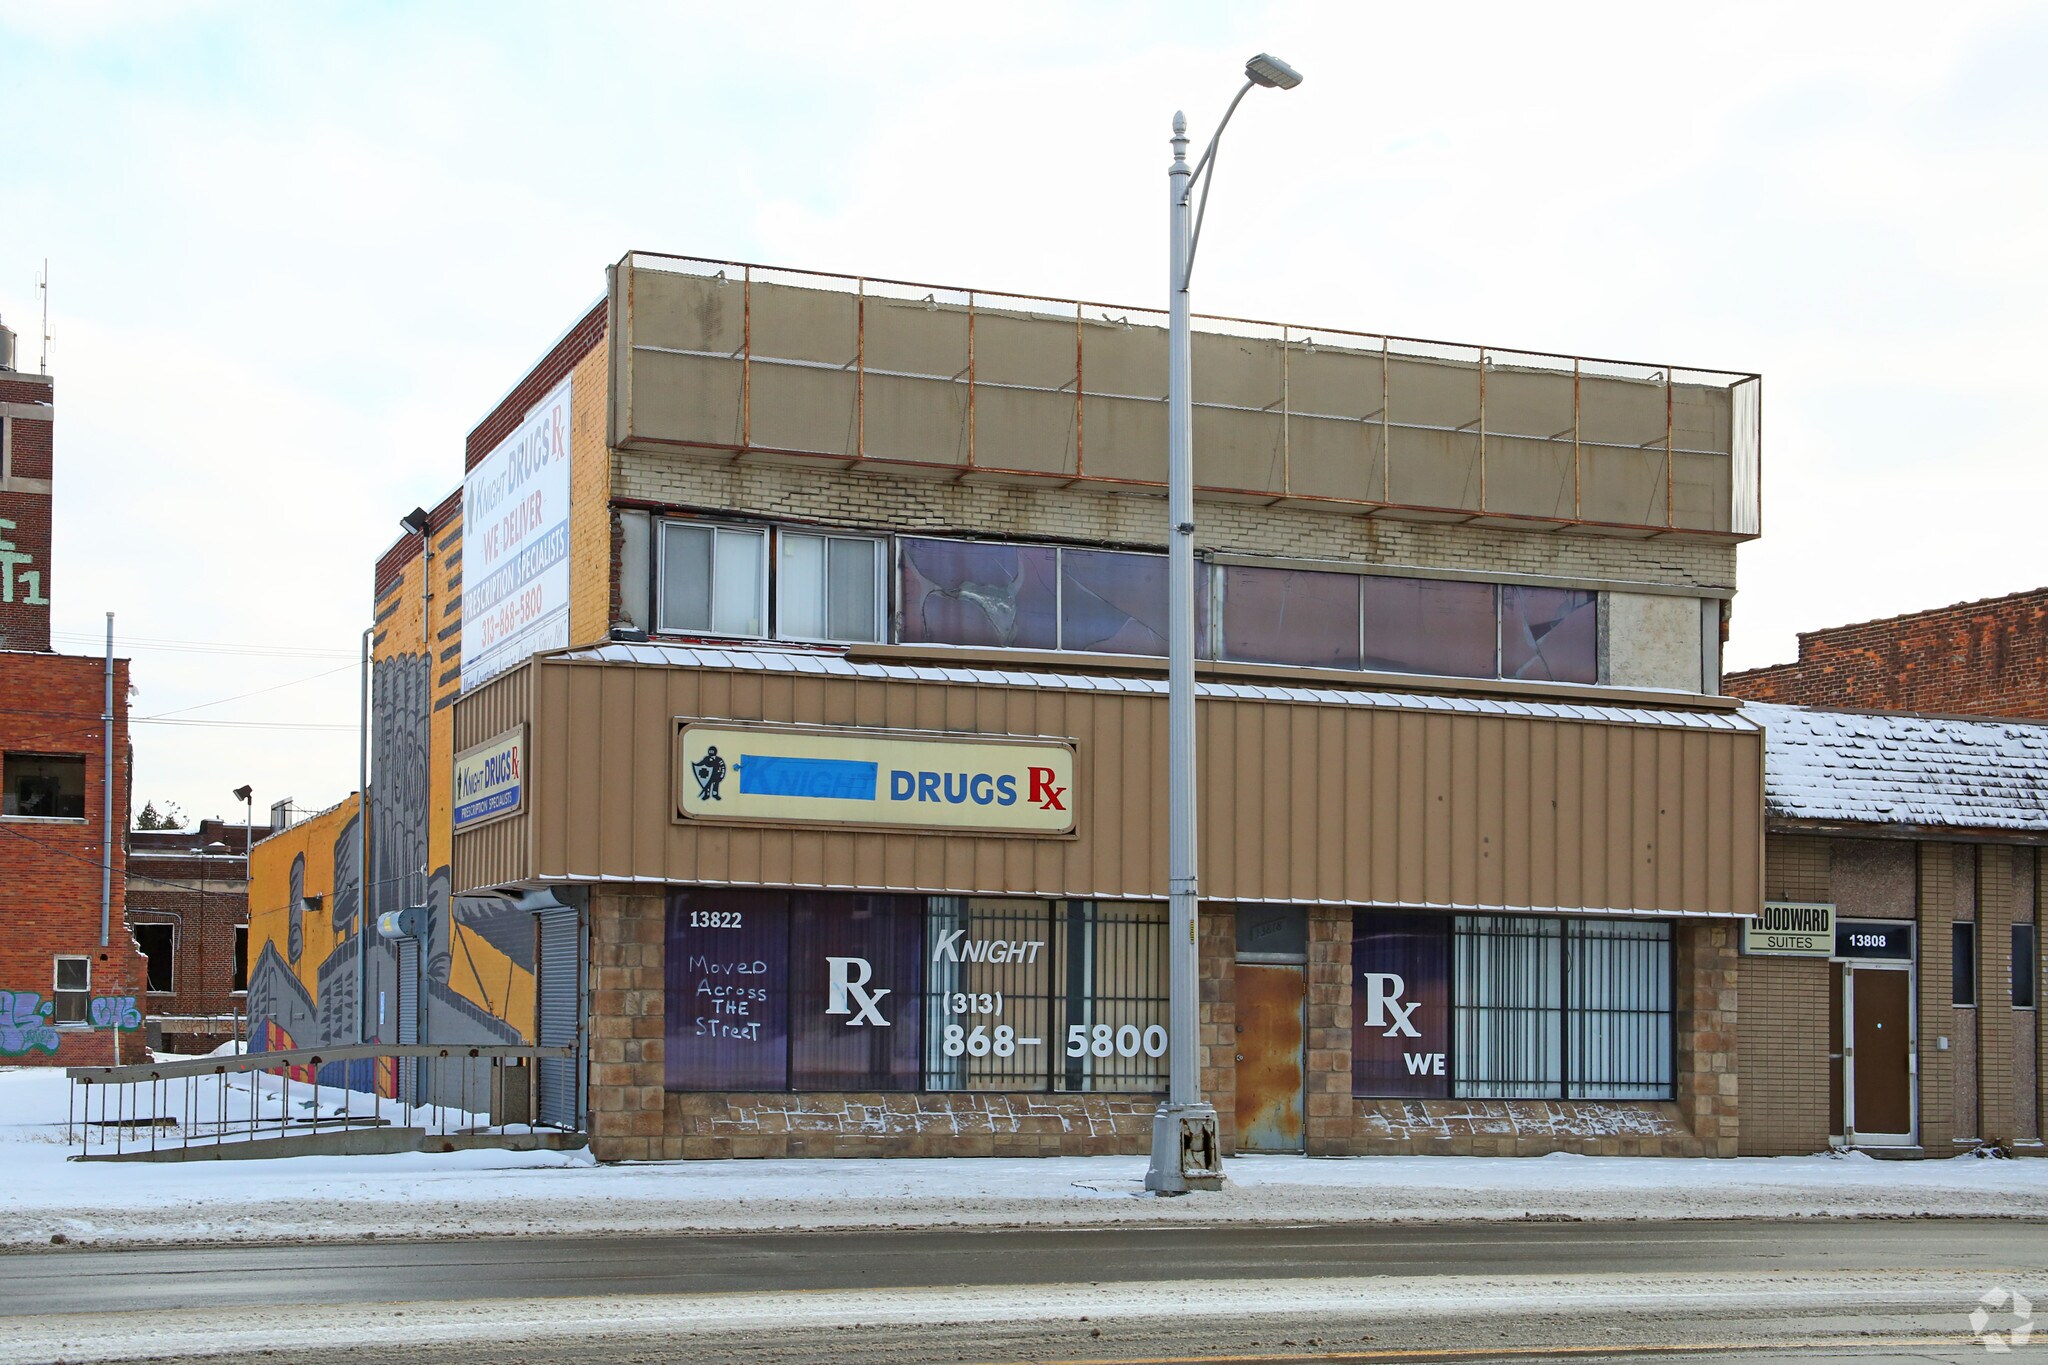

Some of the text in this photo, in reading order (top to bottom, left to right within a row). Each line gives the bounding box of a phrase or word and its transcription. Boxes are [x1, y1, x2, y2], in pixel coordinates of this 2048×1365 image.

[507, 417, 550, 495] DRUGS
[483, 488, 543, 566] WE DELIVER
[464, 525, 565, 621] PRESCRIPTION SPECIALISTS
[481, 583, 543, 648] 313-868-5800
[484, 750, 511, 788] DRUGS
[461, 791, 512, 819] PRESCRIPTION SPECIALISTS
[890, 770, 1017, 806] DRUGS
[1027, 766, 1067, 811] Rx
[690, 911, 742, 929] 13822
[932, 929, 1044, 964] KNIGHT
[1767, 936, 1813, 948] SUITES
[1849, 934, 1886, 947] 13808
[712, 999, 749, 1015] THE
[825, 956, 891, 1026] Rx
[943, 990, 1003, 1016] (313)
[1363, 972, 1422, 1038] Rx
[943, 1024, 1168, 1058] 868- 5800
[1403, 1052, 1446, 1076] WE
